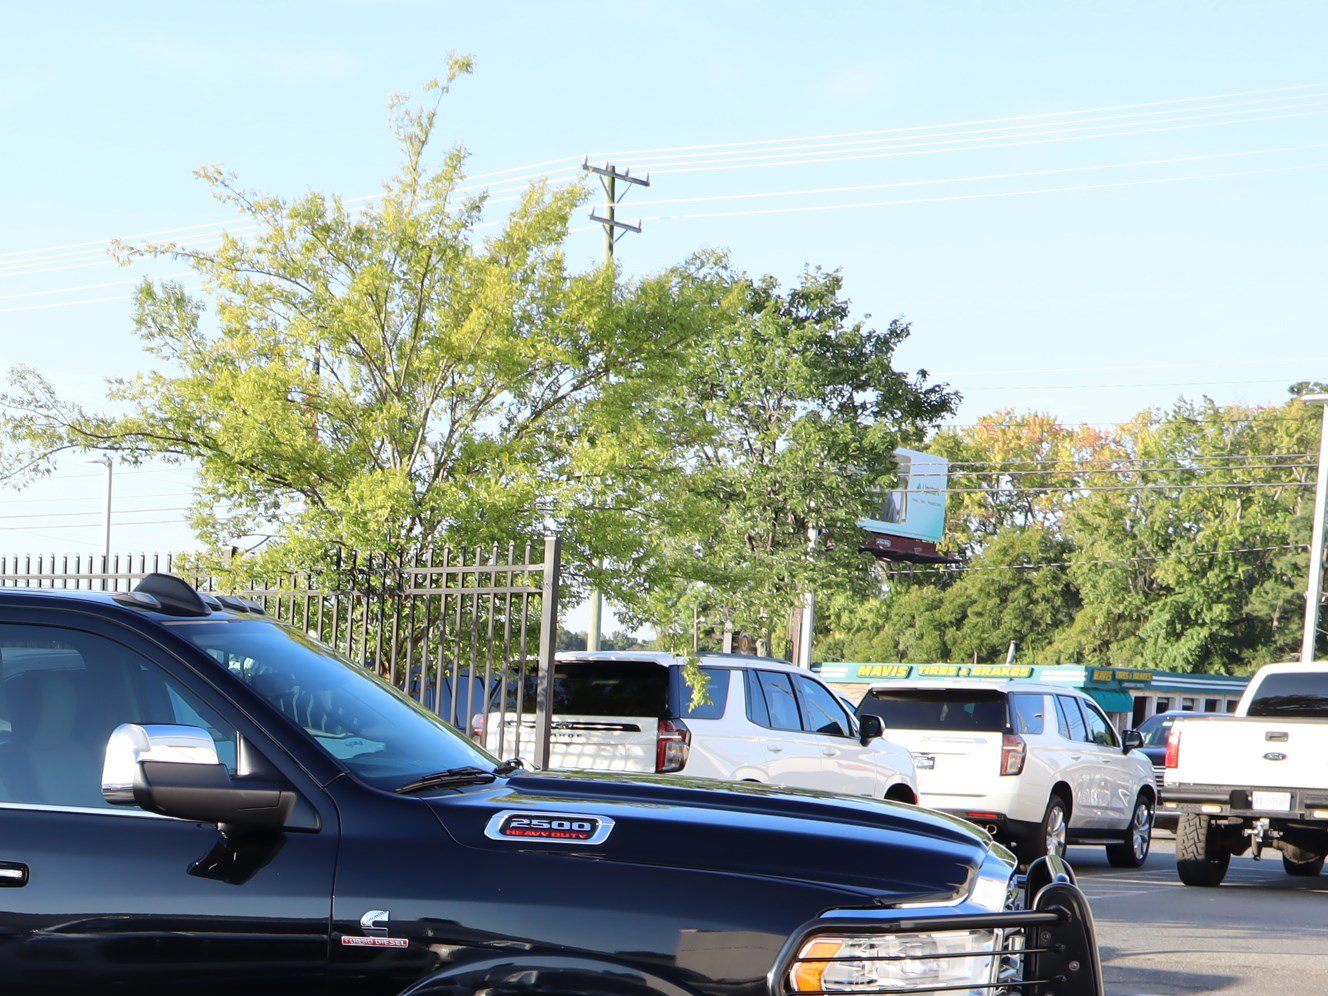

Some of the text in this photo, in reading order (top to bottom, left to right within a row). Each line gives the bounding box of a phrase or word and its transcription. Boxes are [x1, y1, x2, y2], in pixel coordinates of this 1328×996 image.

[857, 665, 910, 678] MAVIS
[918, 665, 958, 677] TIRES
[971, 666, 1031, 678] BRAKES
[509, 818, 591, 831] 2500
[506, 829, 587, 839] HEAVY DUTY
[344, 937, 373, 945] TURBO
